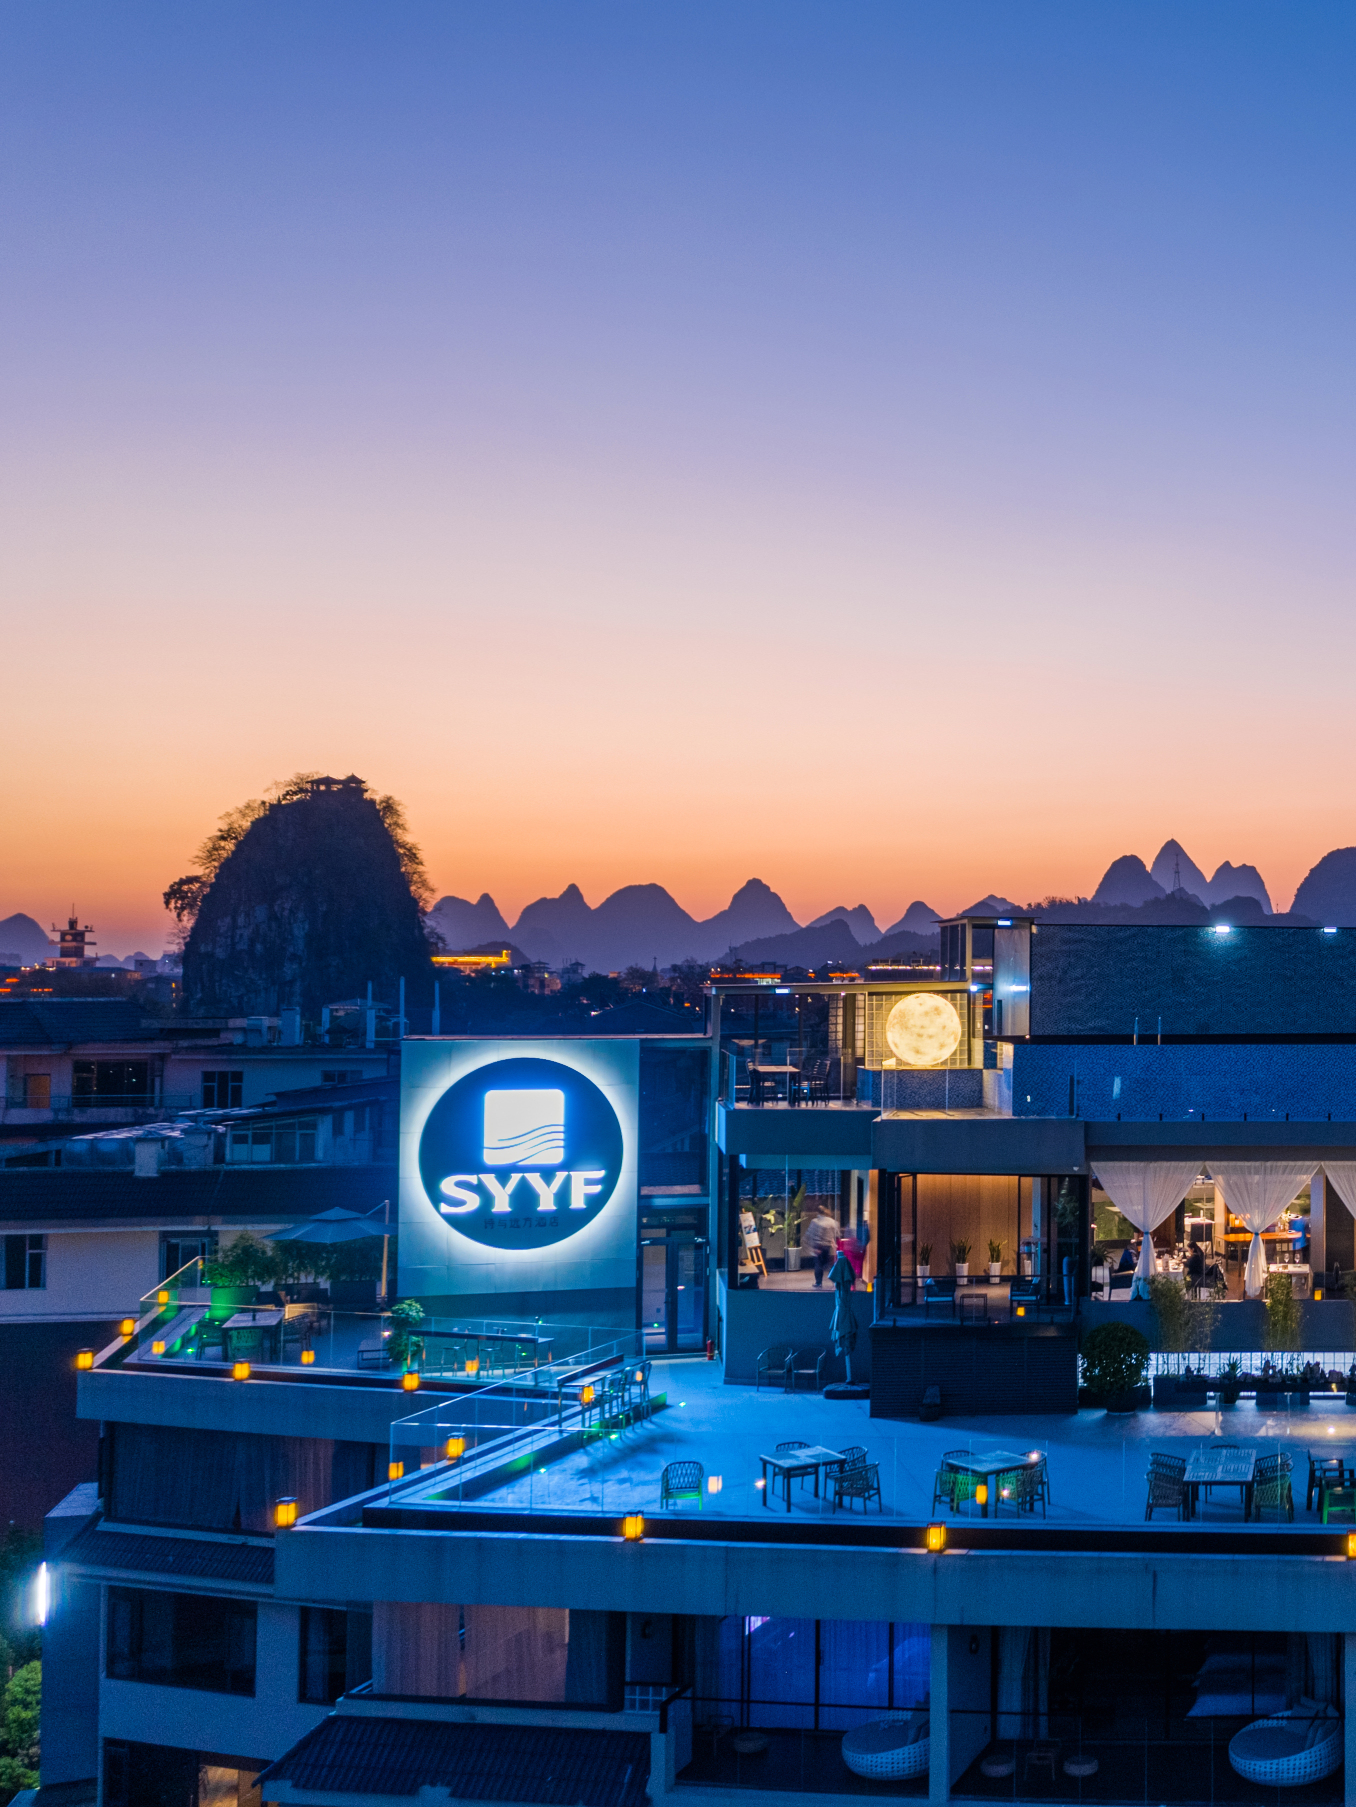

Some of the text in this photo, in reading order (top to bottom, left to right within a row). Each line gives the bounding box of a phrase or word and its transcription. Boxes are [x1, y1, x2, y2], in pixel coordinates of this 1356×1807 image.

[439, 1170, 606, 1214] SYYF
[484, 1216, 560, 1230] 诗与远方酒店
